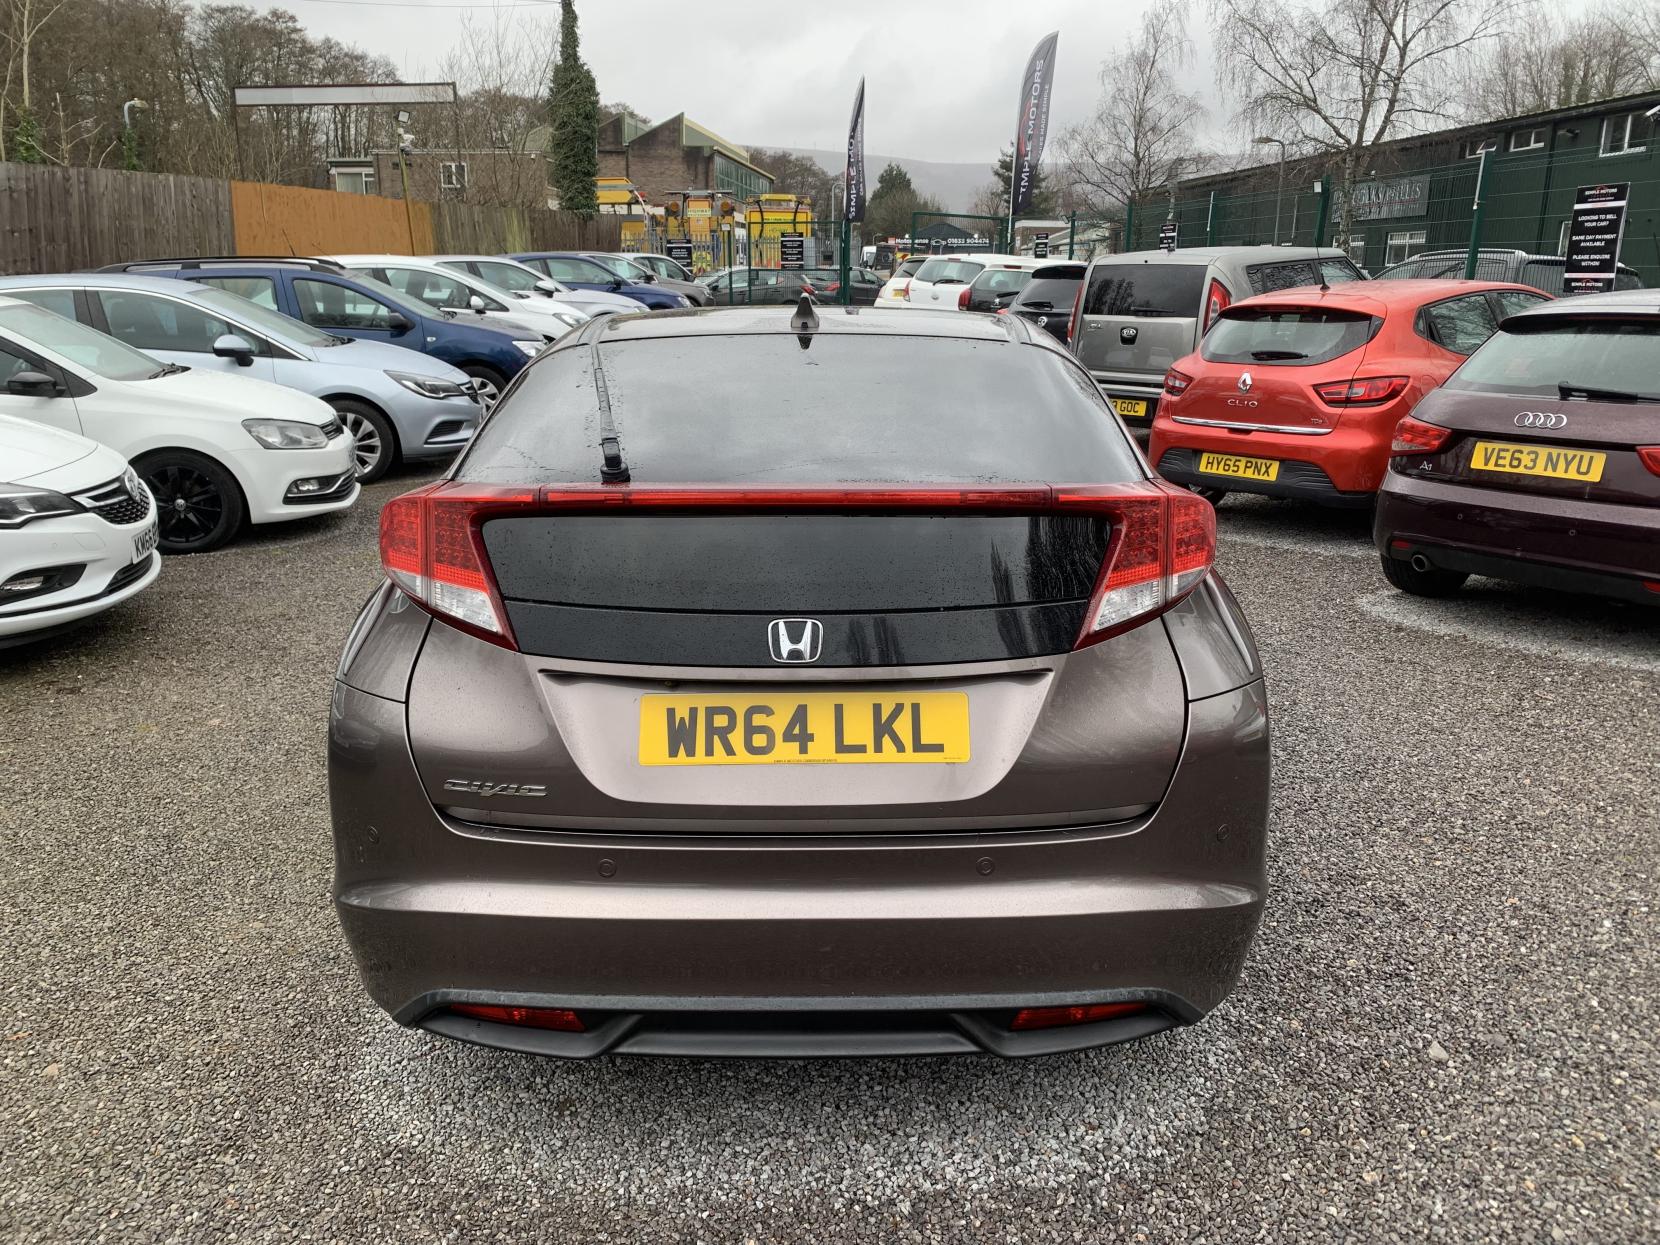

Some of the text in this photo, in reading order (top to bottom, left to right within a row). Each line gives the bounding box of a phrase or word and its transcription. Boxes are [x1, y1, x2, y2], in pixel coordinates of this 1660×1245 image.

[1028, 59, 1044, 135] MOTORS
[848, 167, 857, 219] SIMPLE
[1120, 401, 1140, 413] GOC
[1227, 399, 1258, 408] CLIO
[1204, 455, 1272, 478] HY65 PNX
[1483, 447, 1594, 476] VE63 NYU
[666, 702, 945, 758] WR64 LKL
[443, 779, 547, 797] CIVIC
